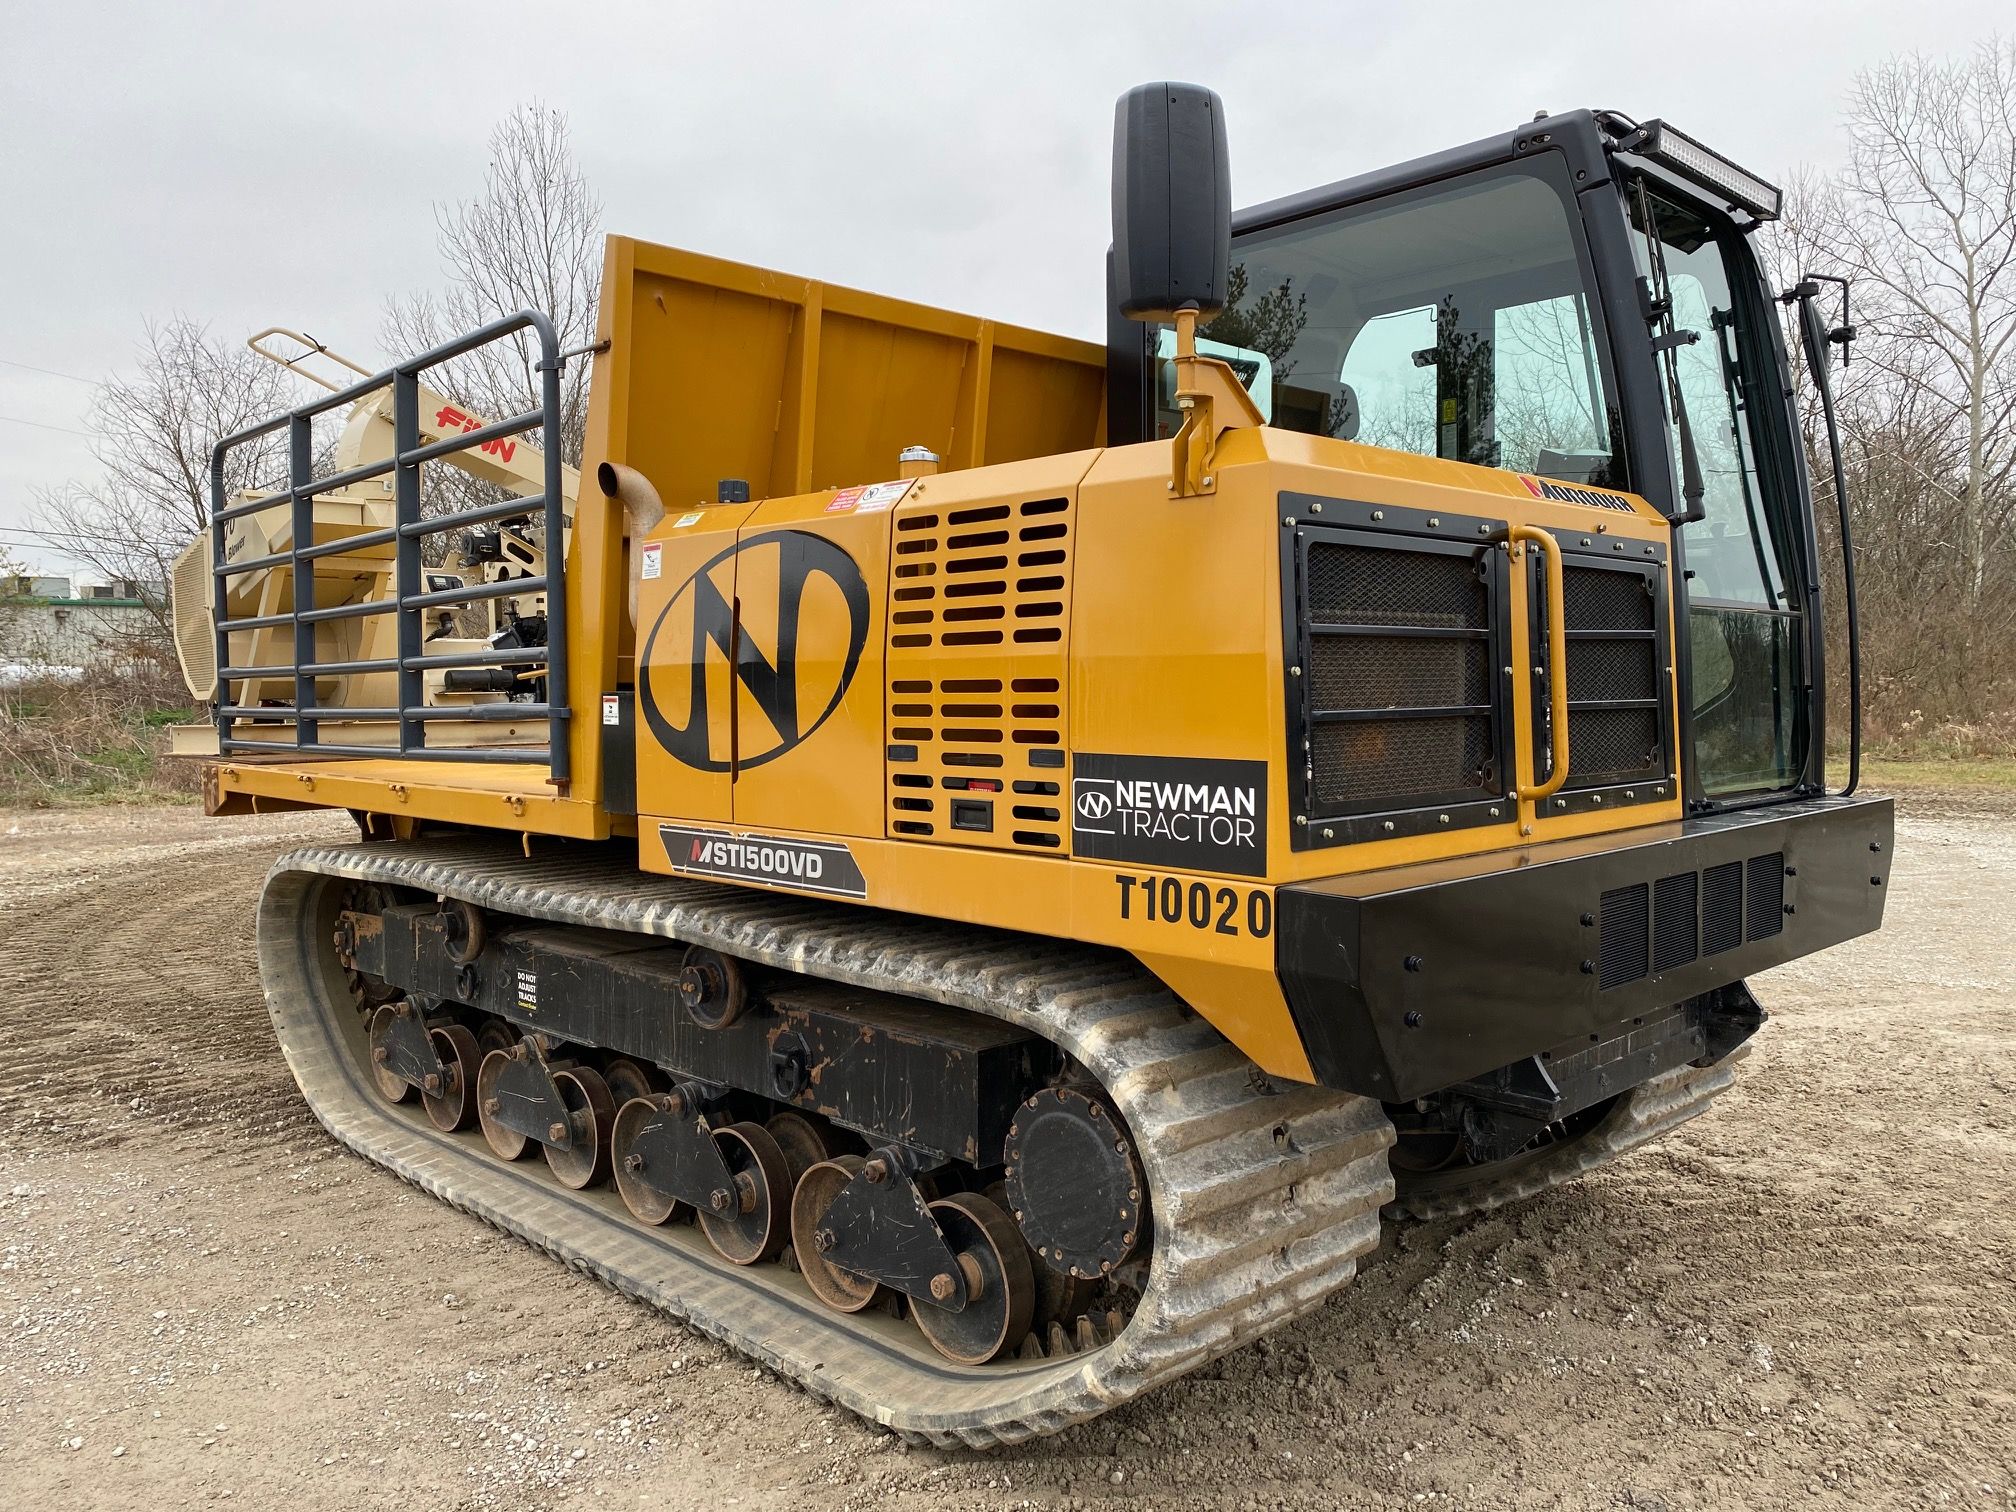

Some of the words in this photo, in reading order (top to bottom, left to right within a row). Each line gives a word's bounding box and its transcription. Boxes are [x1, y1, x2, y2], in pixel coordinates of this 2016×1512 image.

[1116, 780, 1255, 817] NEWMAN
[1116, 808, 1255, 848] TRACTOR
[1115, 874, 1271, 938] T10020
[517, 972, 525, 980] DO
[526, 974, 536, 984] NOT
[518, 982, 536, 993] ADJUST
[518, 991, 536, 1003] TRACKS
